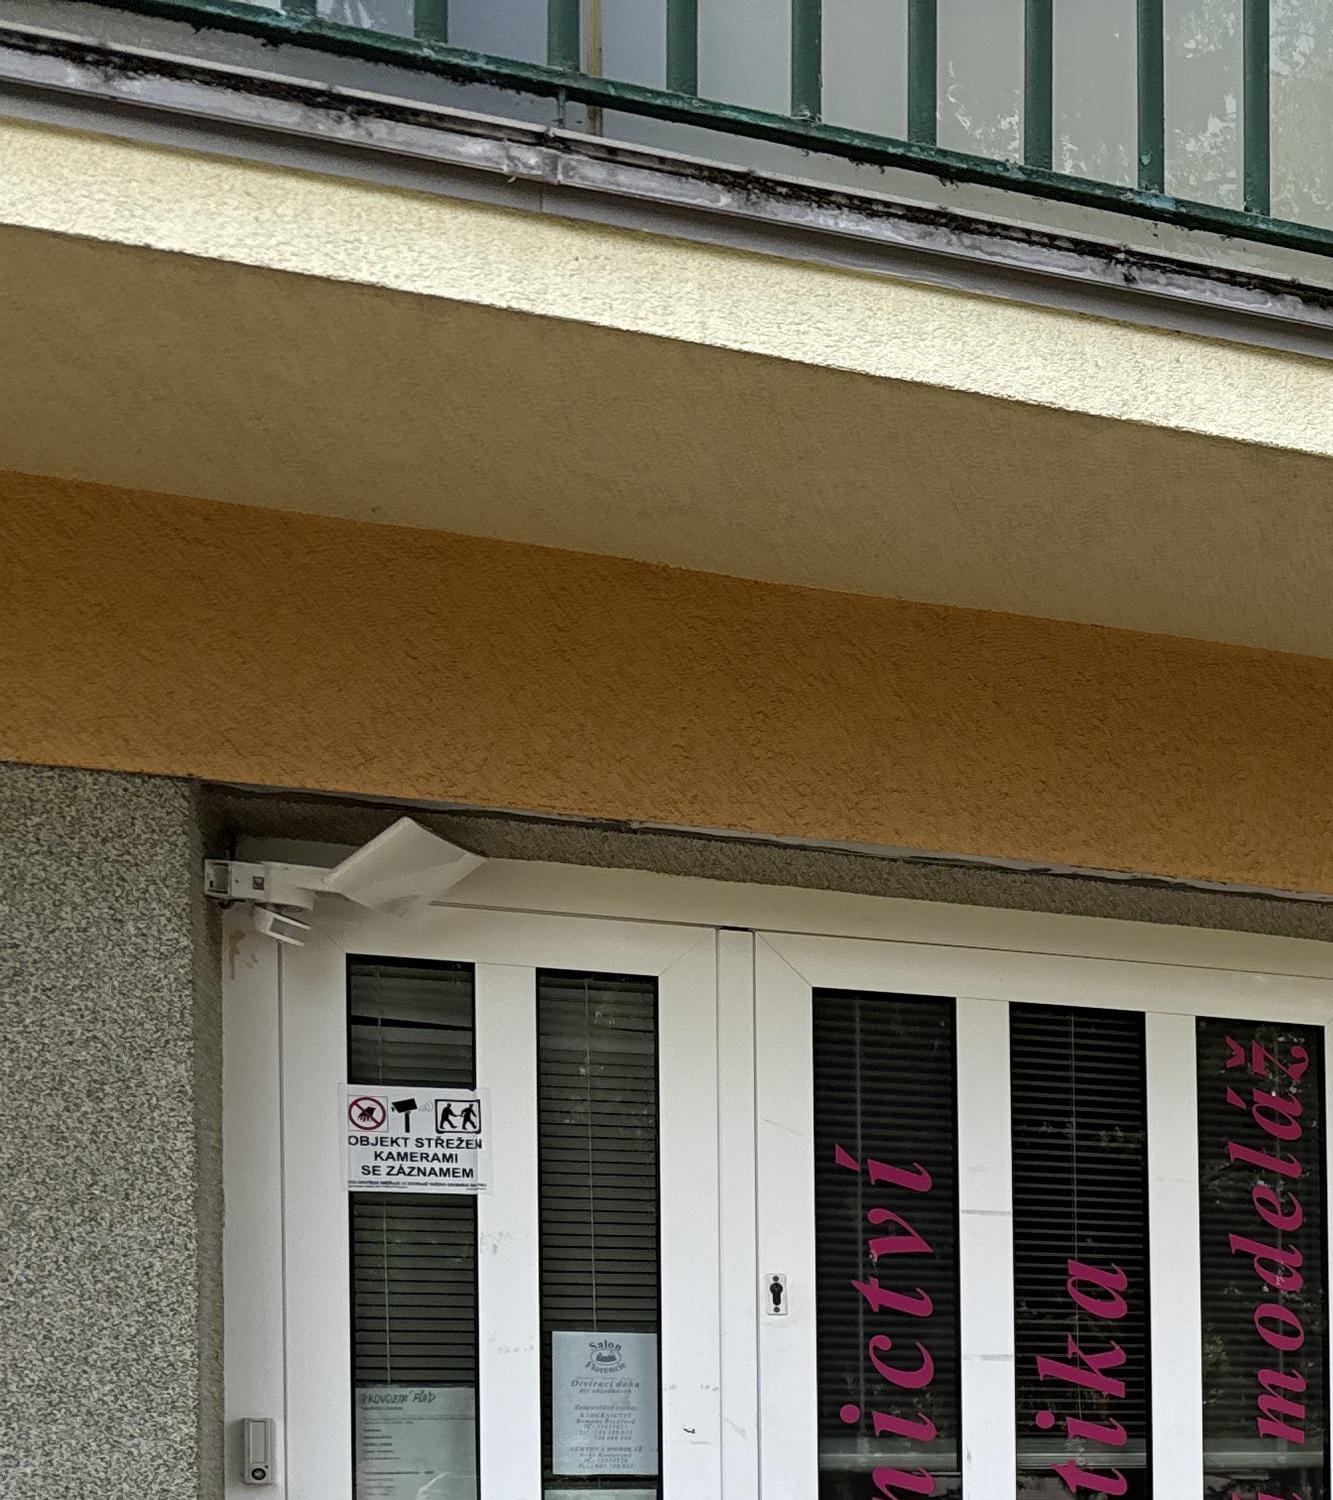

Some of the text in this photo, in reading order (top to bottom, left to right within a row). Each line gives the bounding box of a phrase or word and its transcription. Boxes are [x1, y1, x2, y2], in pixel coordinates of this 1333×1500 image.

[348, 1135, 482, 1149] OBJEKT STŘEŽEN
[374, 1151, 458, 1163] KAMERAMI
[361, 1165, 474, 1178] SE ZÁZNAMEM
[1225, 1035, 1310, 1446] modeláž
[588, 1340, 622, 1351] Salon
